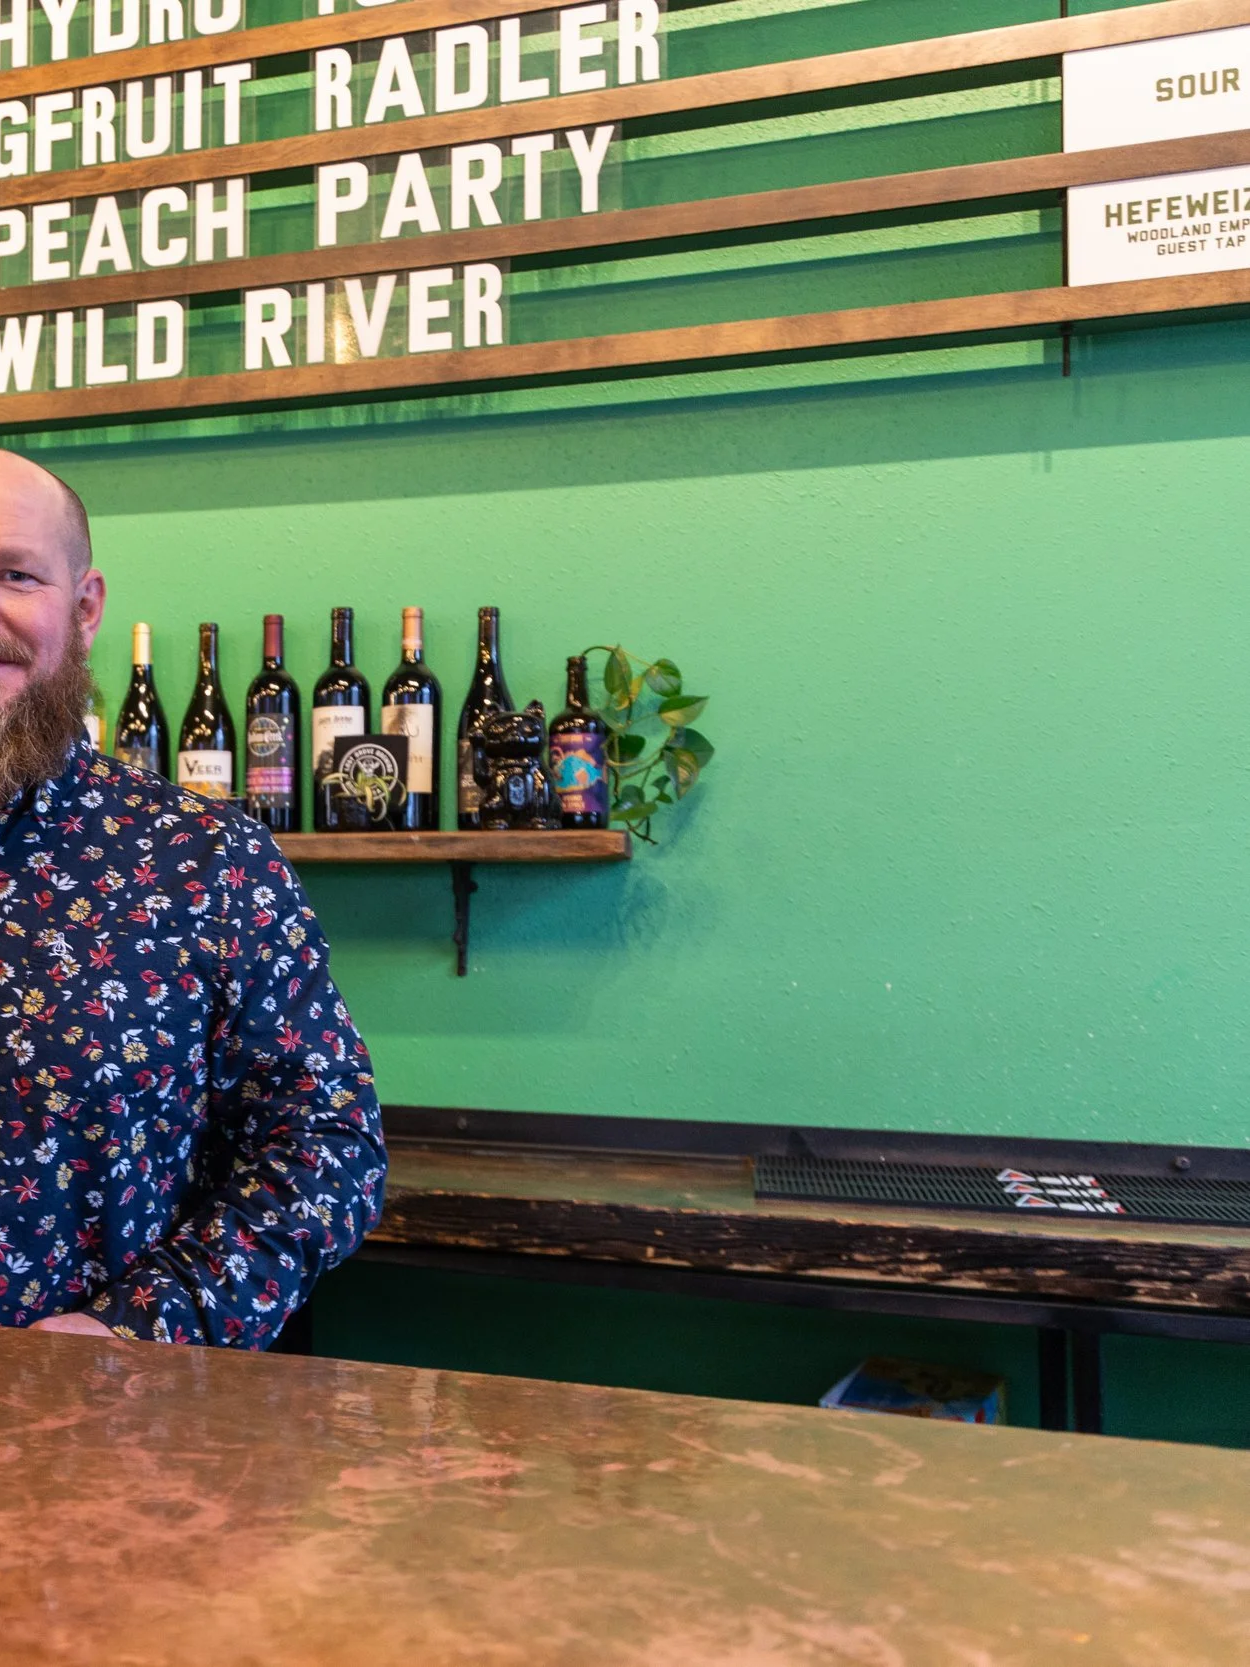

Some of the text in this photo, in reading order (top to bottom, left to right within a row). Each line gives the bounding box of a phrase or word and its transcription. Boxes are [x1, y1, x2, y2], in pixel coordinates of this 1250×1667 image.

[315, 1, 660, 131] RADLER
[1155, 68, 1241, 102] SOUR
[318, 125, 615, 247] PARTY
[1127, 222, 1212, 243] WOODLAND
[1157, 235, 1246, 256] GUEST TAP
[245, 262, 503, 371] RIVER
